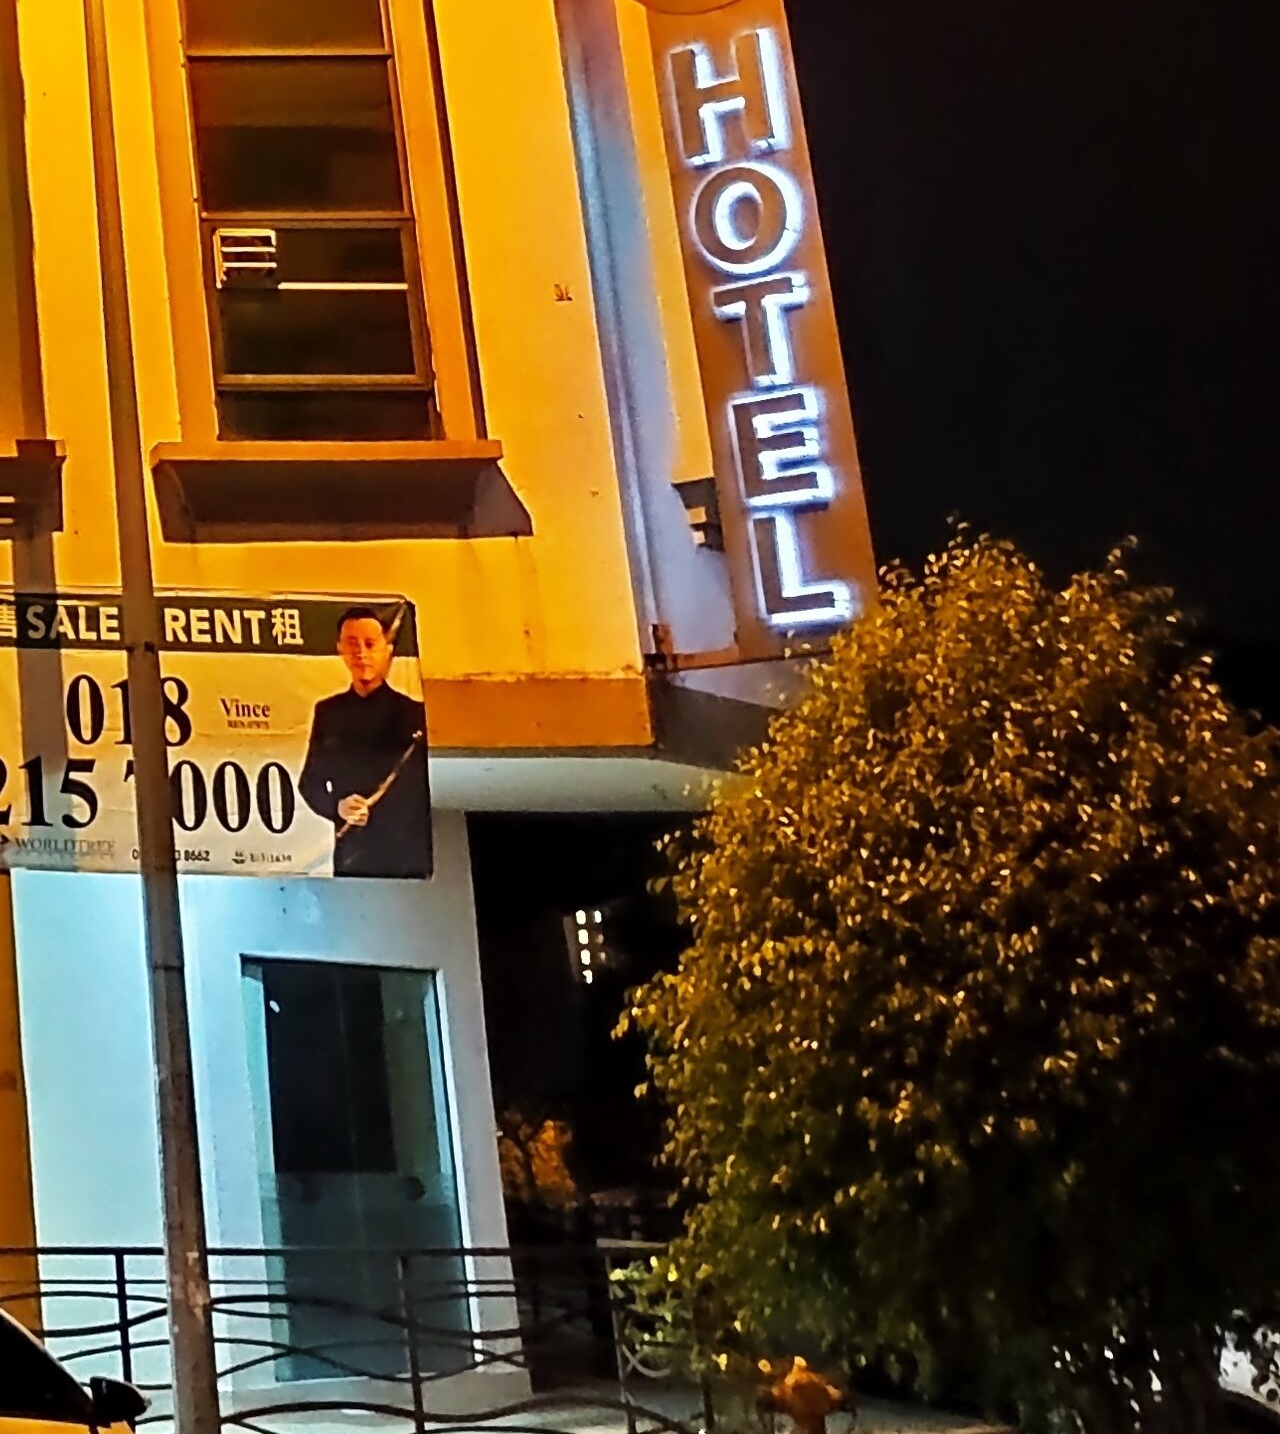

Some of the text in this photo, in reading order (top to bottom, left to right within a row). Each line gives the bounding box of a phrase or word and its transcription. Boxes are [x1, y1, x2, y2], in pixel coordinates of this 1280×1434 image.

[668, 27, 851, 626] HOTEL
[26, 605, 121, 641] SALE
[164, 608, 265, 645] RENT
[272, 608, 304, 646] 租
[66, 674, 192, 747] 018
[220, 698, 271, 718] Vince
